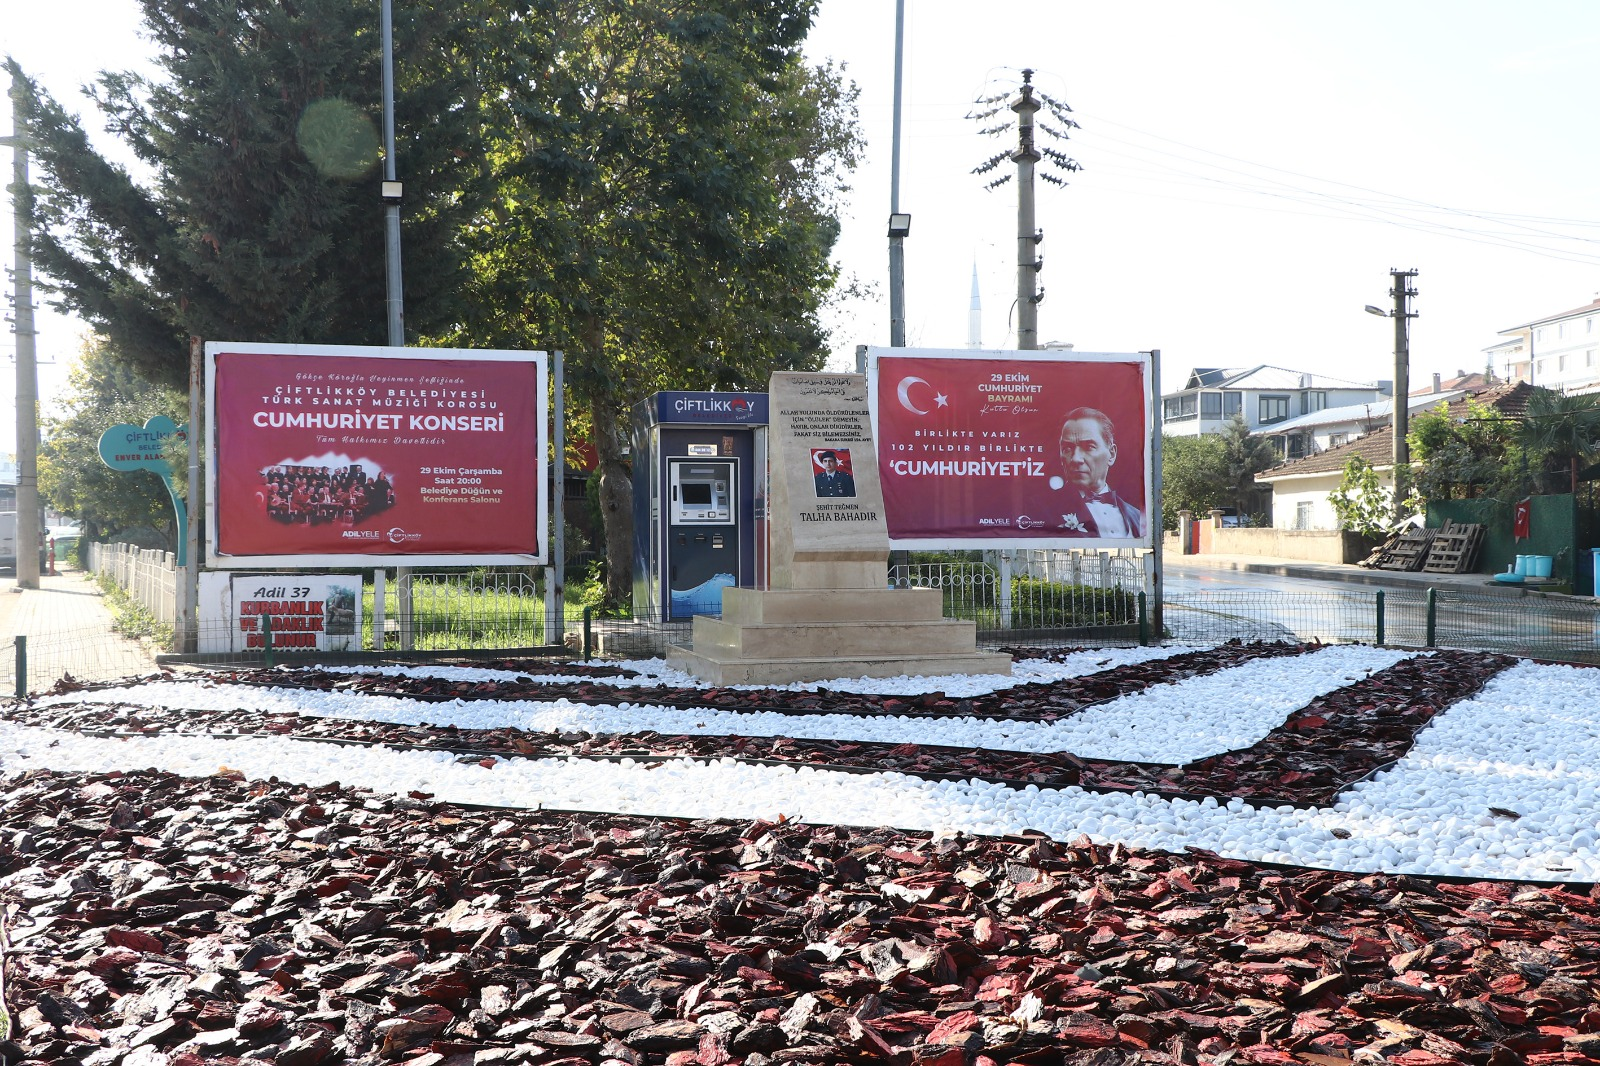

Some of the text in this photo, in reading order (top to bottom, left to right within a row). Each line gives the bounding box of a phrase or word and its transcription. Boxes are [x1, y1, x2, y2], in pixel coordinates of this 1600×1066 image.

[991, 372, 1029, 382] 29 EKİM
[275, 385, 485, 399] ÇİFTLİKKÖY BELEDİYESİ
[978, 382, 1042, 393] CUMHURİYET
[263, 394, 497, 409] TÜRK SANAT MÜZİĞİ KOROSU
[988, 395, 1033, 403] BAYRAMI
[253, 409, 504, 432] CUMHURİYET KONSERİ
[915, 429, 974, 437] BİRLİKTE
[923, 444, 970, 452] YILDIR
[980, 444, 1043, 452] BİRLİKTE
[433, 467, 456, 475] Ekim
[459, 467, 503, 476] Çarşamba
[434, 477, 481, 485] Saat 20:00
[420, 487, 458, 496] Belediye
[461, 487, 490, 496] Düğün
[423, 496, 468, 504] Konferans
[800, 512, 877, 521] TALHA BAHADIR
[253, 586, 311, 598] Adil 37
[240, 601, 324, 615] KURBANLIK
[239, 617, 258, 631] VE
